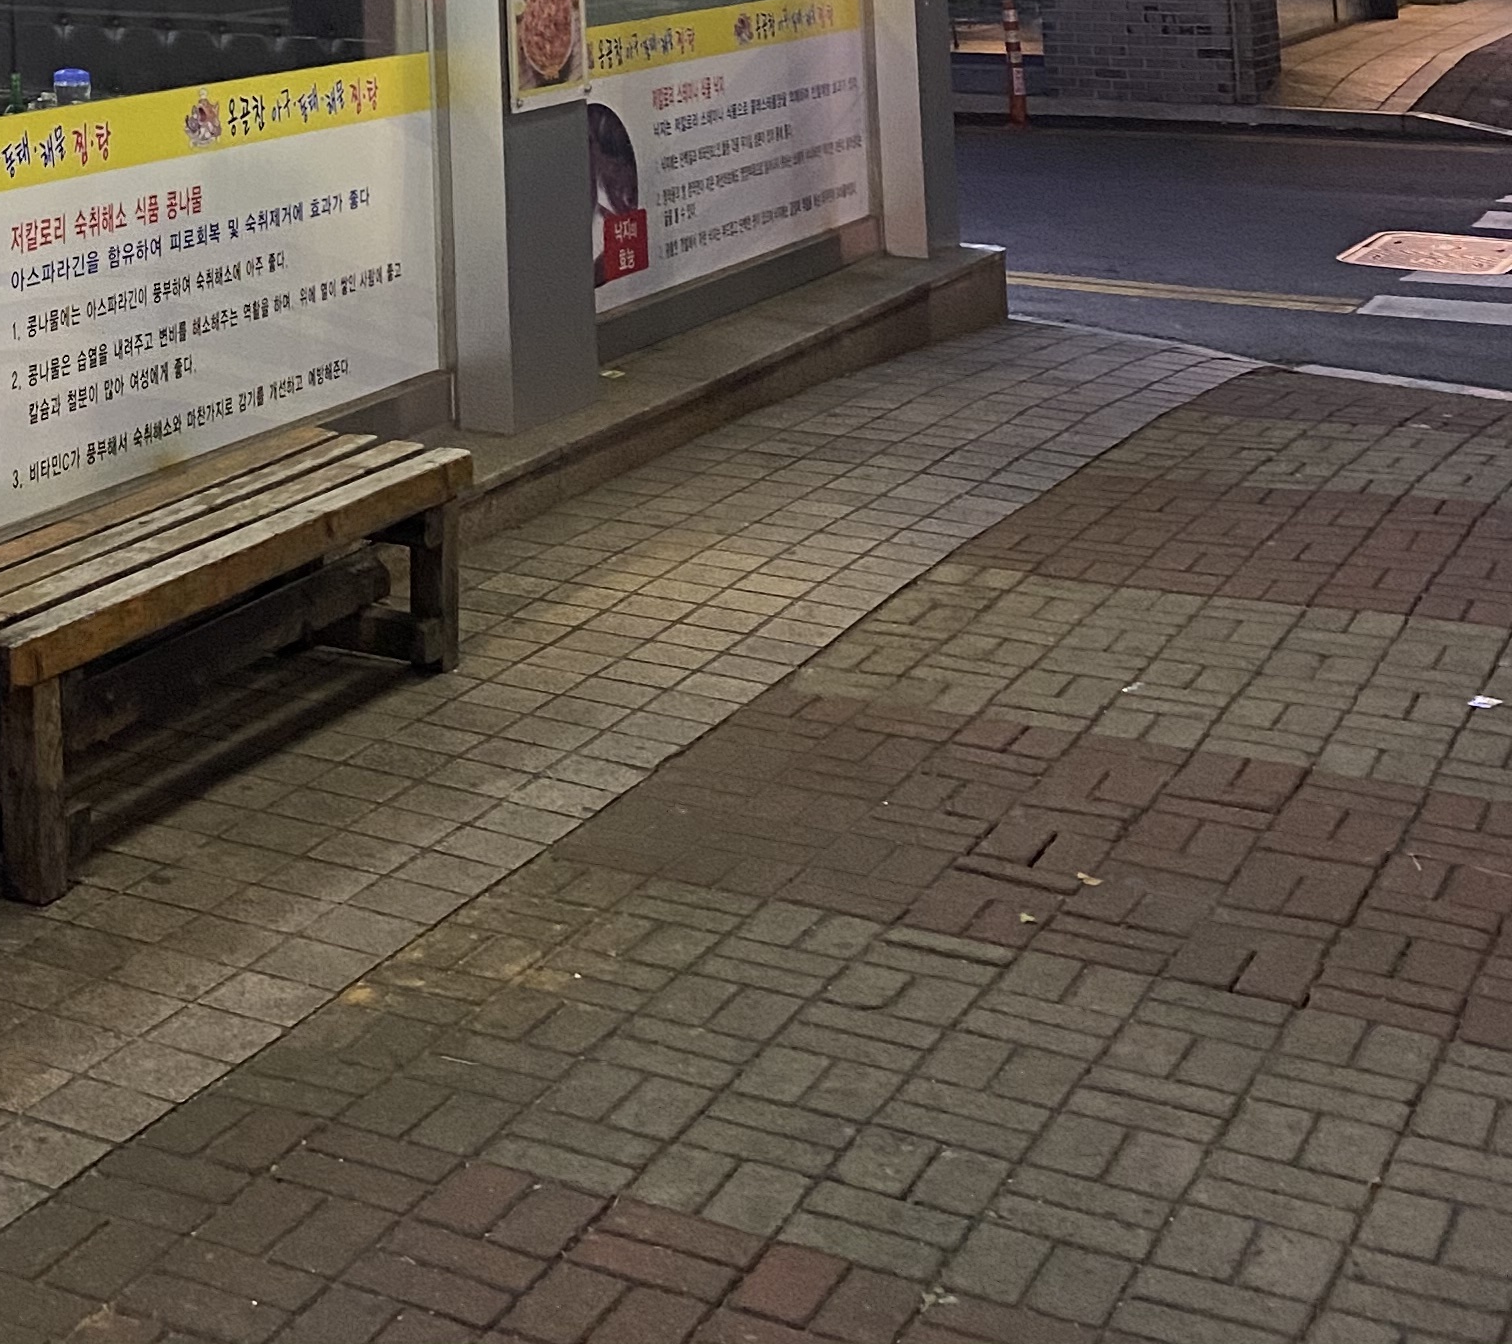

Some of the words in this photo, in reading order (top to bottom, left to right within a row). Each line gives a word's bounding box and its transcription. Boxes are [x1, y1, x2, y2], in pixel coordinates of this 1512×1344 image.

[227, 95, 267, 136] 옹골찬
[10, 215, 66, 255] 저칼로리
[74, 201, 129, 240] 숙취해소
[134, 194, 160, 226] 식품
[166, 184, 203, 218] 콩나물
[10, 249, 100, 293] 아스파라긴을
[108, 235, 163, 270] 함유하여
[169, 219, 222, 253] 피로회복
[227, 218, 240, 240] 및
[244, 202, 305, 235] 숙취제거에
[309, 194, 344, 219] 효과가
[349, 186, 371, 210] 좋다
[618, 247, 636, 271] 효능
[26, 304, 81, 340] 콩나물에는
[86, 284, 149, 321] 아스파라긴이
[152, 276, 192, 306] 풍부하여
[195, 261, 242, 293] 숙취해소에
[245, 257, 264, 279] 아주
[27, 352, 72, 388] 콩나물은
[76, 342, 108, 373] 습열을
[114, 329, 154, 360] 내려주고
[158, 316, 188, 348] 변비를
[191, 305, 239, 337] 해소해주는
[28, 396, 62, 425] 칼슘과
[66, 384, 99, 414] 철분이
[103, 376, 126, 403] 많아
[129, 361, 170, 392] 여성에게
[28, 446, 81, 483] 비타민C가
